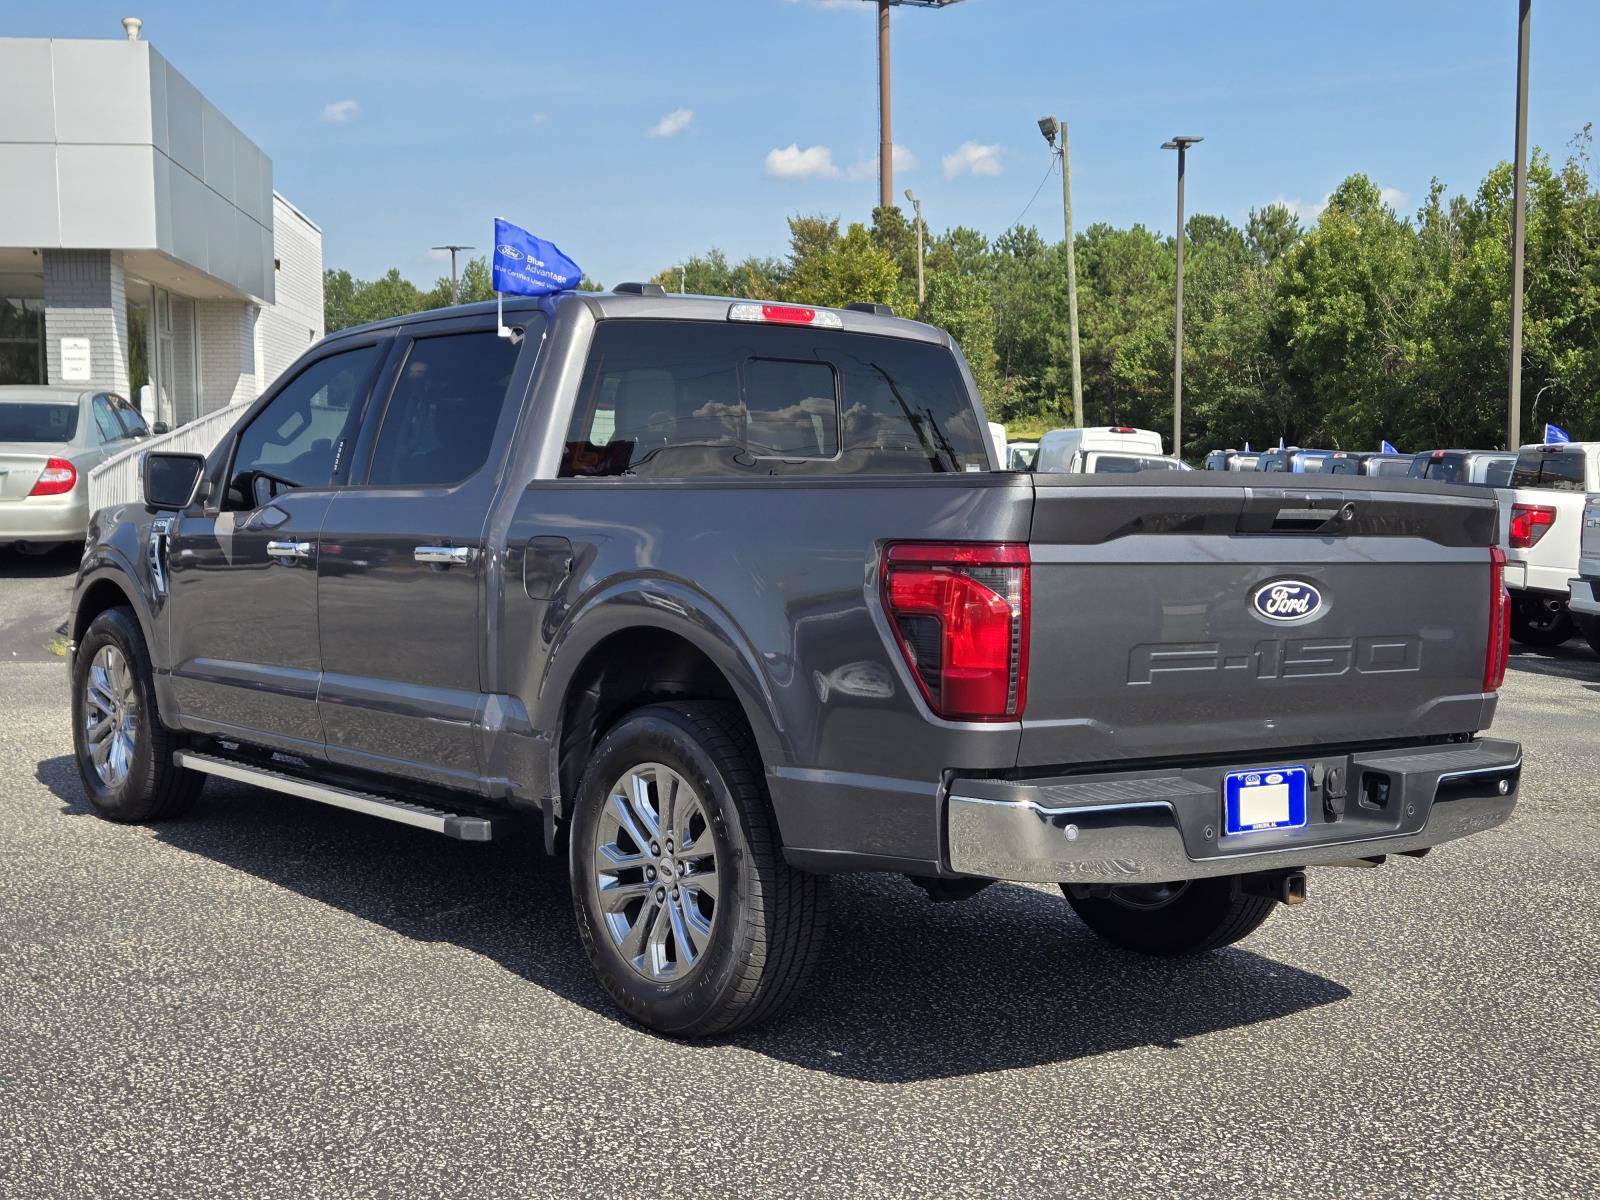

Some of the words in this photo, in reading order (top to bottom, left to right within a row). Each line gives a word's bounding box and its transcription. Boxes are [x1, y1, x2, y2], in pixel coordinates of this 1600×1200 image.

[501, 245, 520, 258] Ford
[526, 254, 545, 268] Blue
[525, 264, 567, 284] Advantage
[1266, 585, 1310, 614] Ford
[1126, 633, 1423, 685] F-150
